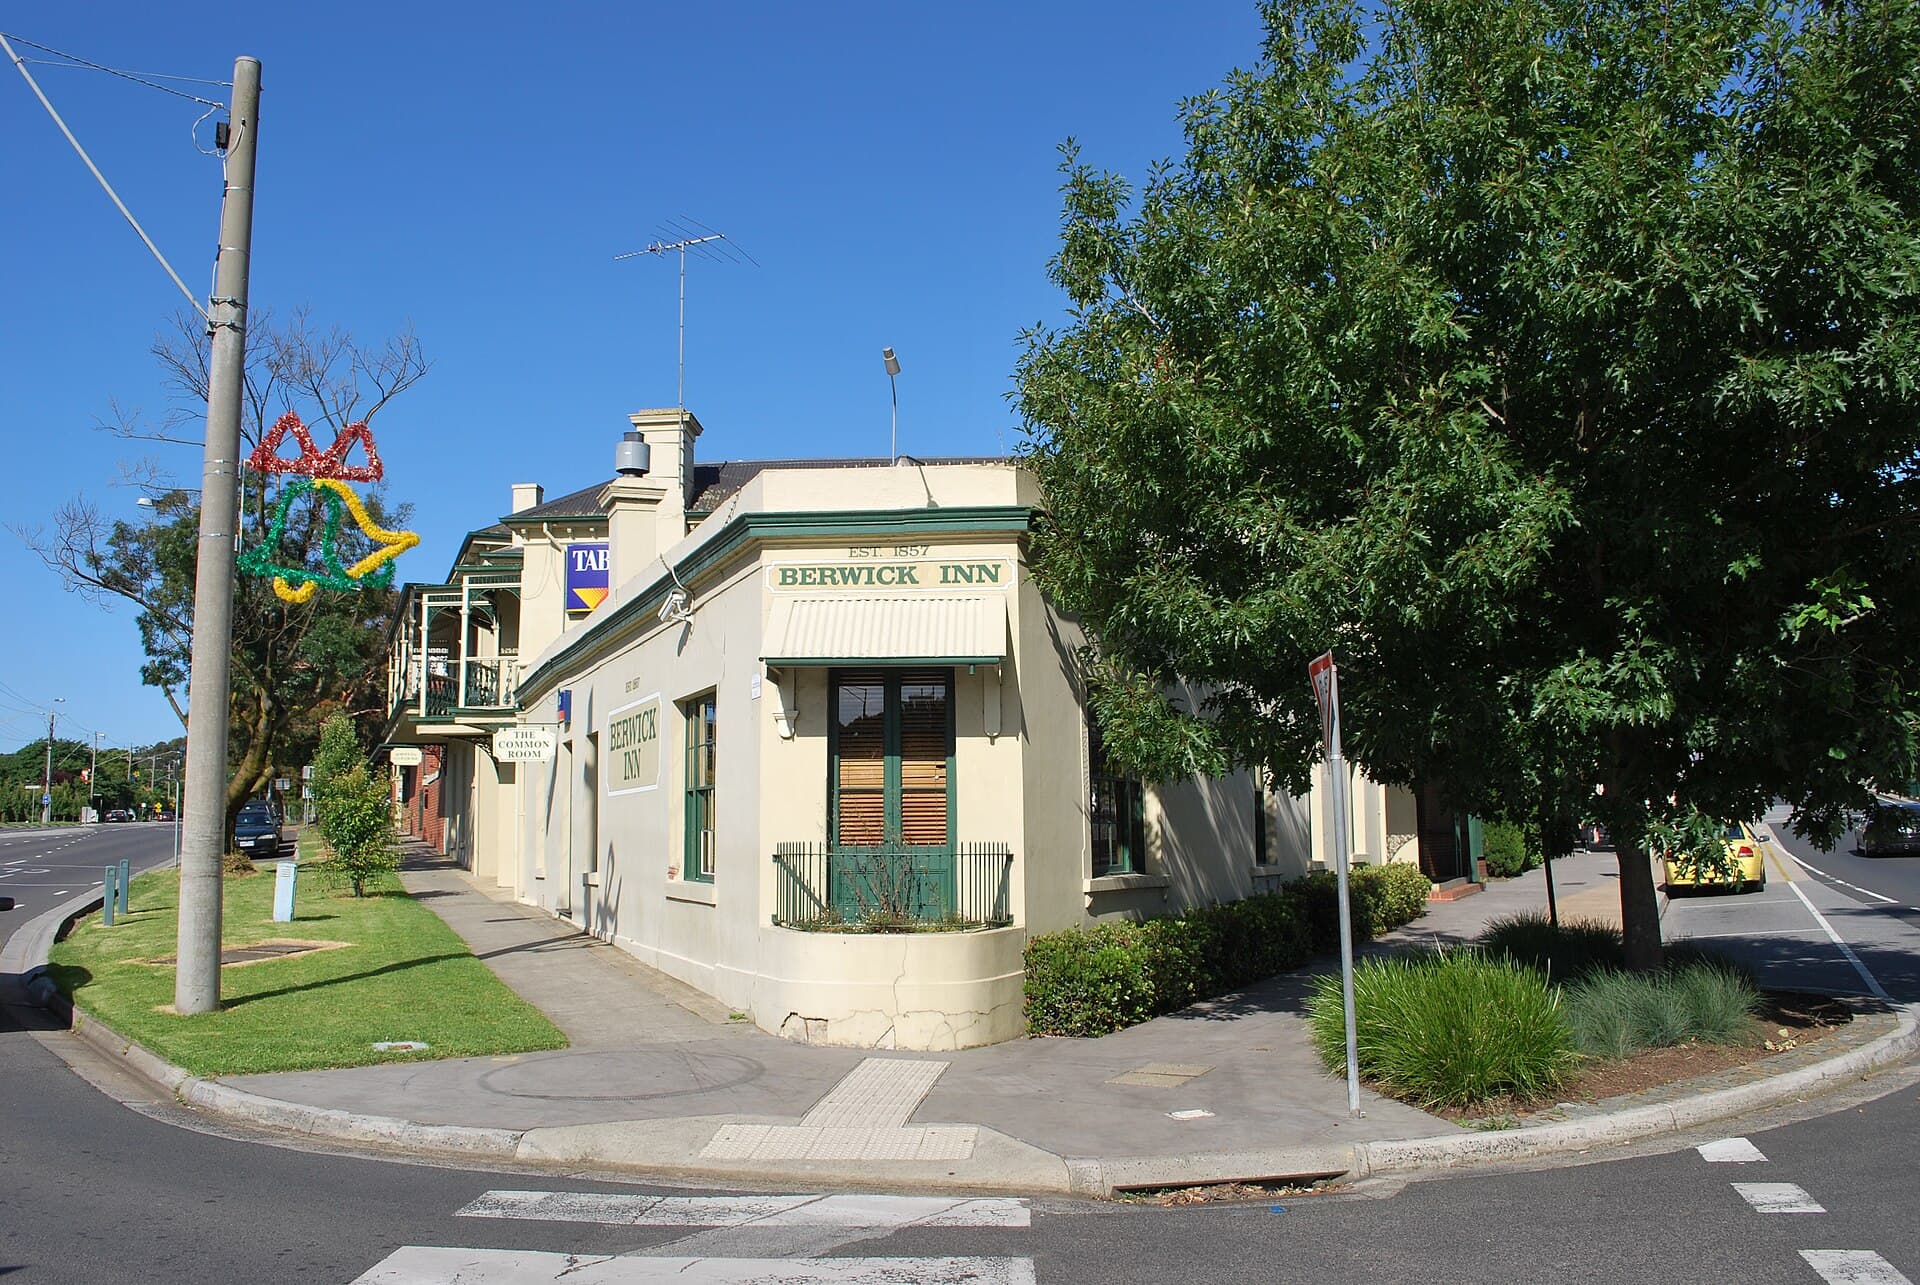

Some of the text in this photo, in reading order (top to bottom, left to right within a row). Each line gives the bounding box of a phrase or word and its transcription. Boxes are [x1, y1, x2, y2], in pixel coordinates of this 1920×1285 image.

[572, 549, 609, 571] TAB
[849, 545, 930, 558] EST. 1857
[778, 563, 1001, 586] BERWICK INN
[515, 731, 535, 739] THE
[610, 708, 656, 752] BERWICK
[498, 740, 550, 748] COMMON
[508, 750, 541, 758] ROOM
[624, 748, 641, 781] INN
